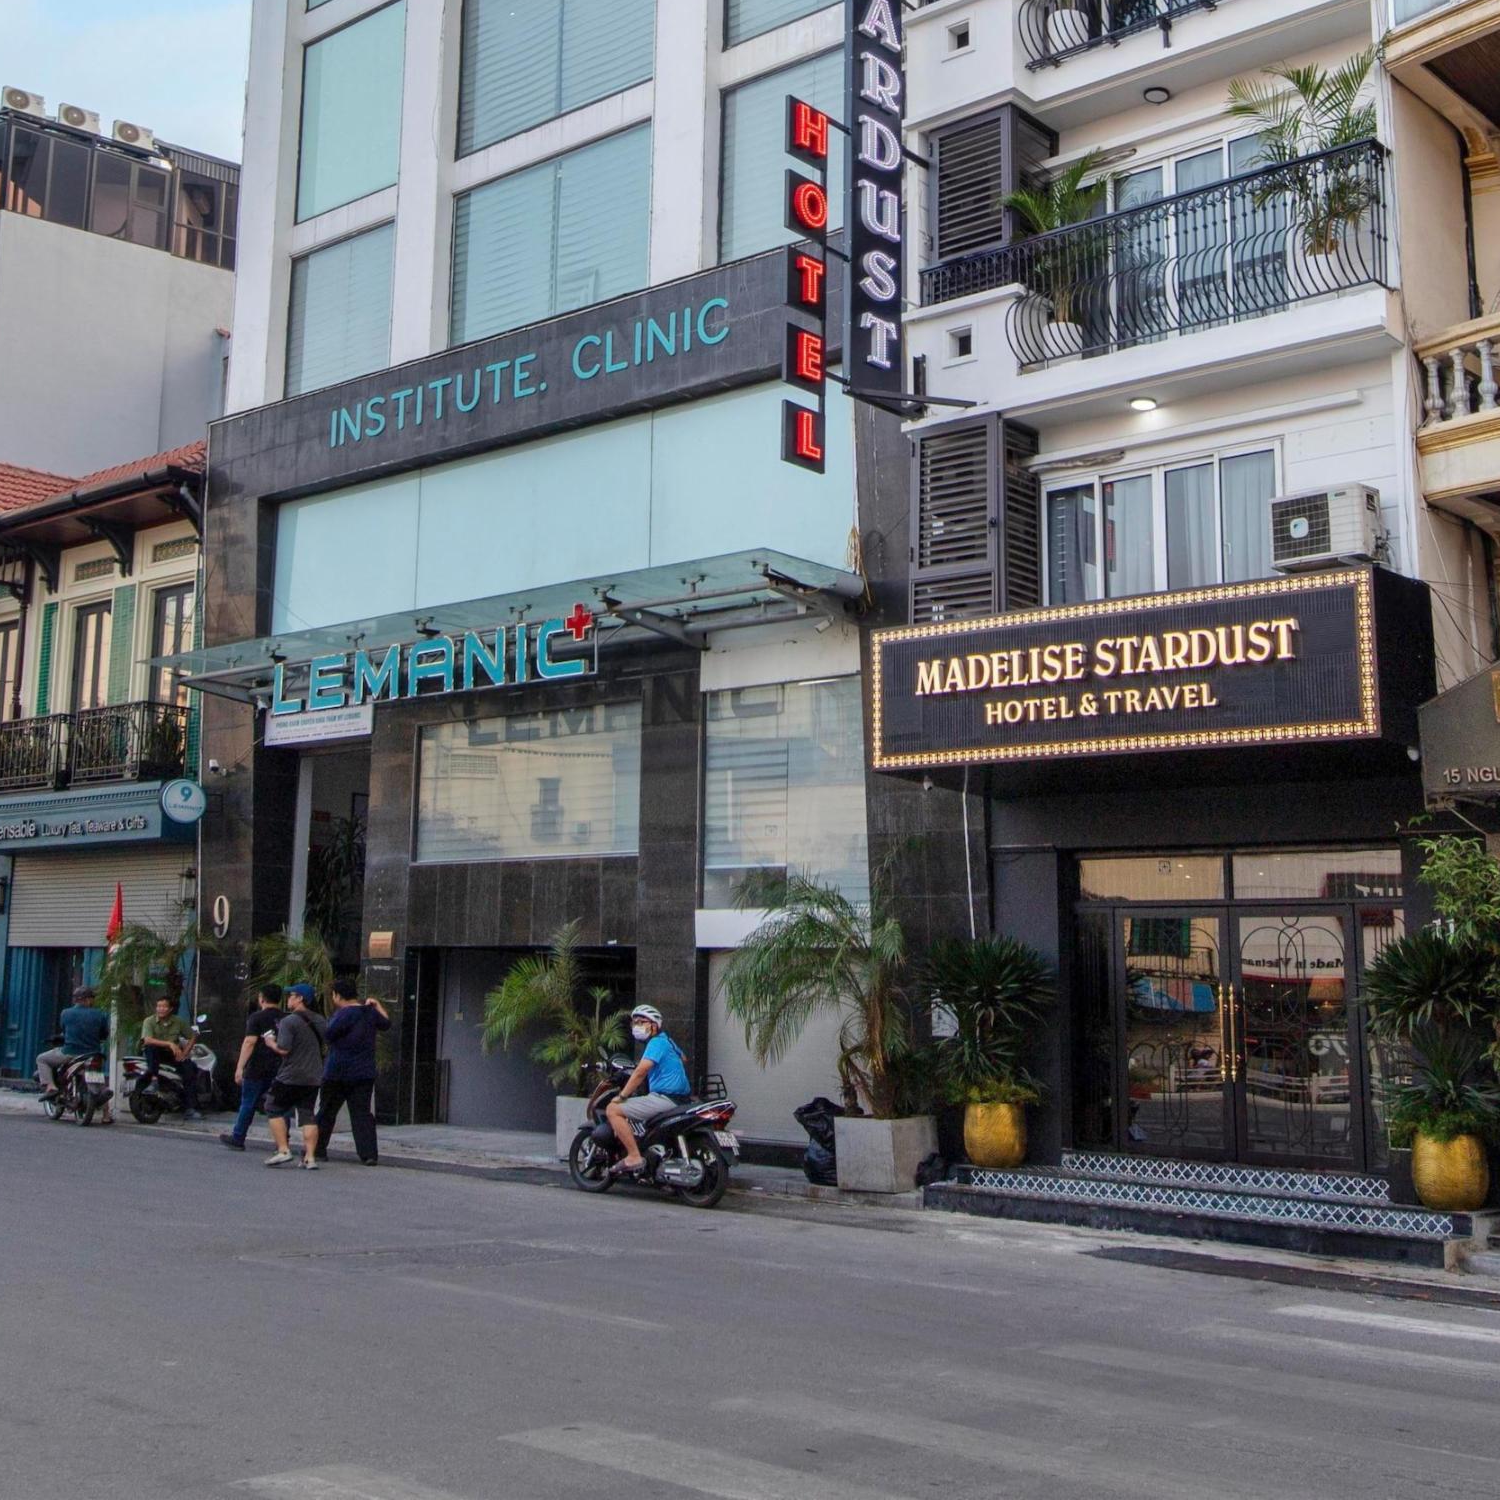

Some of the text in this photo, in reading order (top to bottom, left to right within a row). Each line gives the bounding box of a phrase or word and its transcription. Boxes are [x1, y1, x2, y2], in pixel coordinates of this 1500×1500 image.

[793, 98, 828, 461] HOTEL
[571, 297, 730, 380] CLINIC
[271, 618, 590, 716] LEMANIC
[915, 618, 1300, 697] MADELISE STARDUST
[985, 683, 1219, 726] HOTEL & TRAVEL
[180, 785, 193, 802] 9
[1444, 768, 1461, 784] 15
[213, 895, 231, 939] 9
